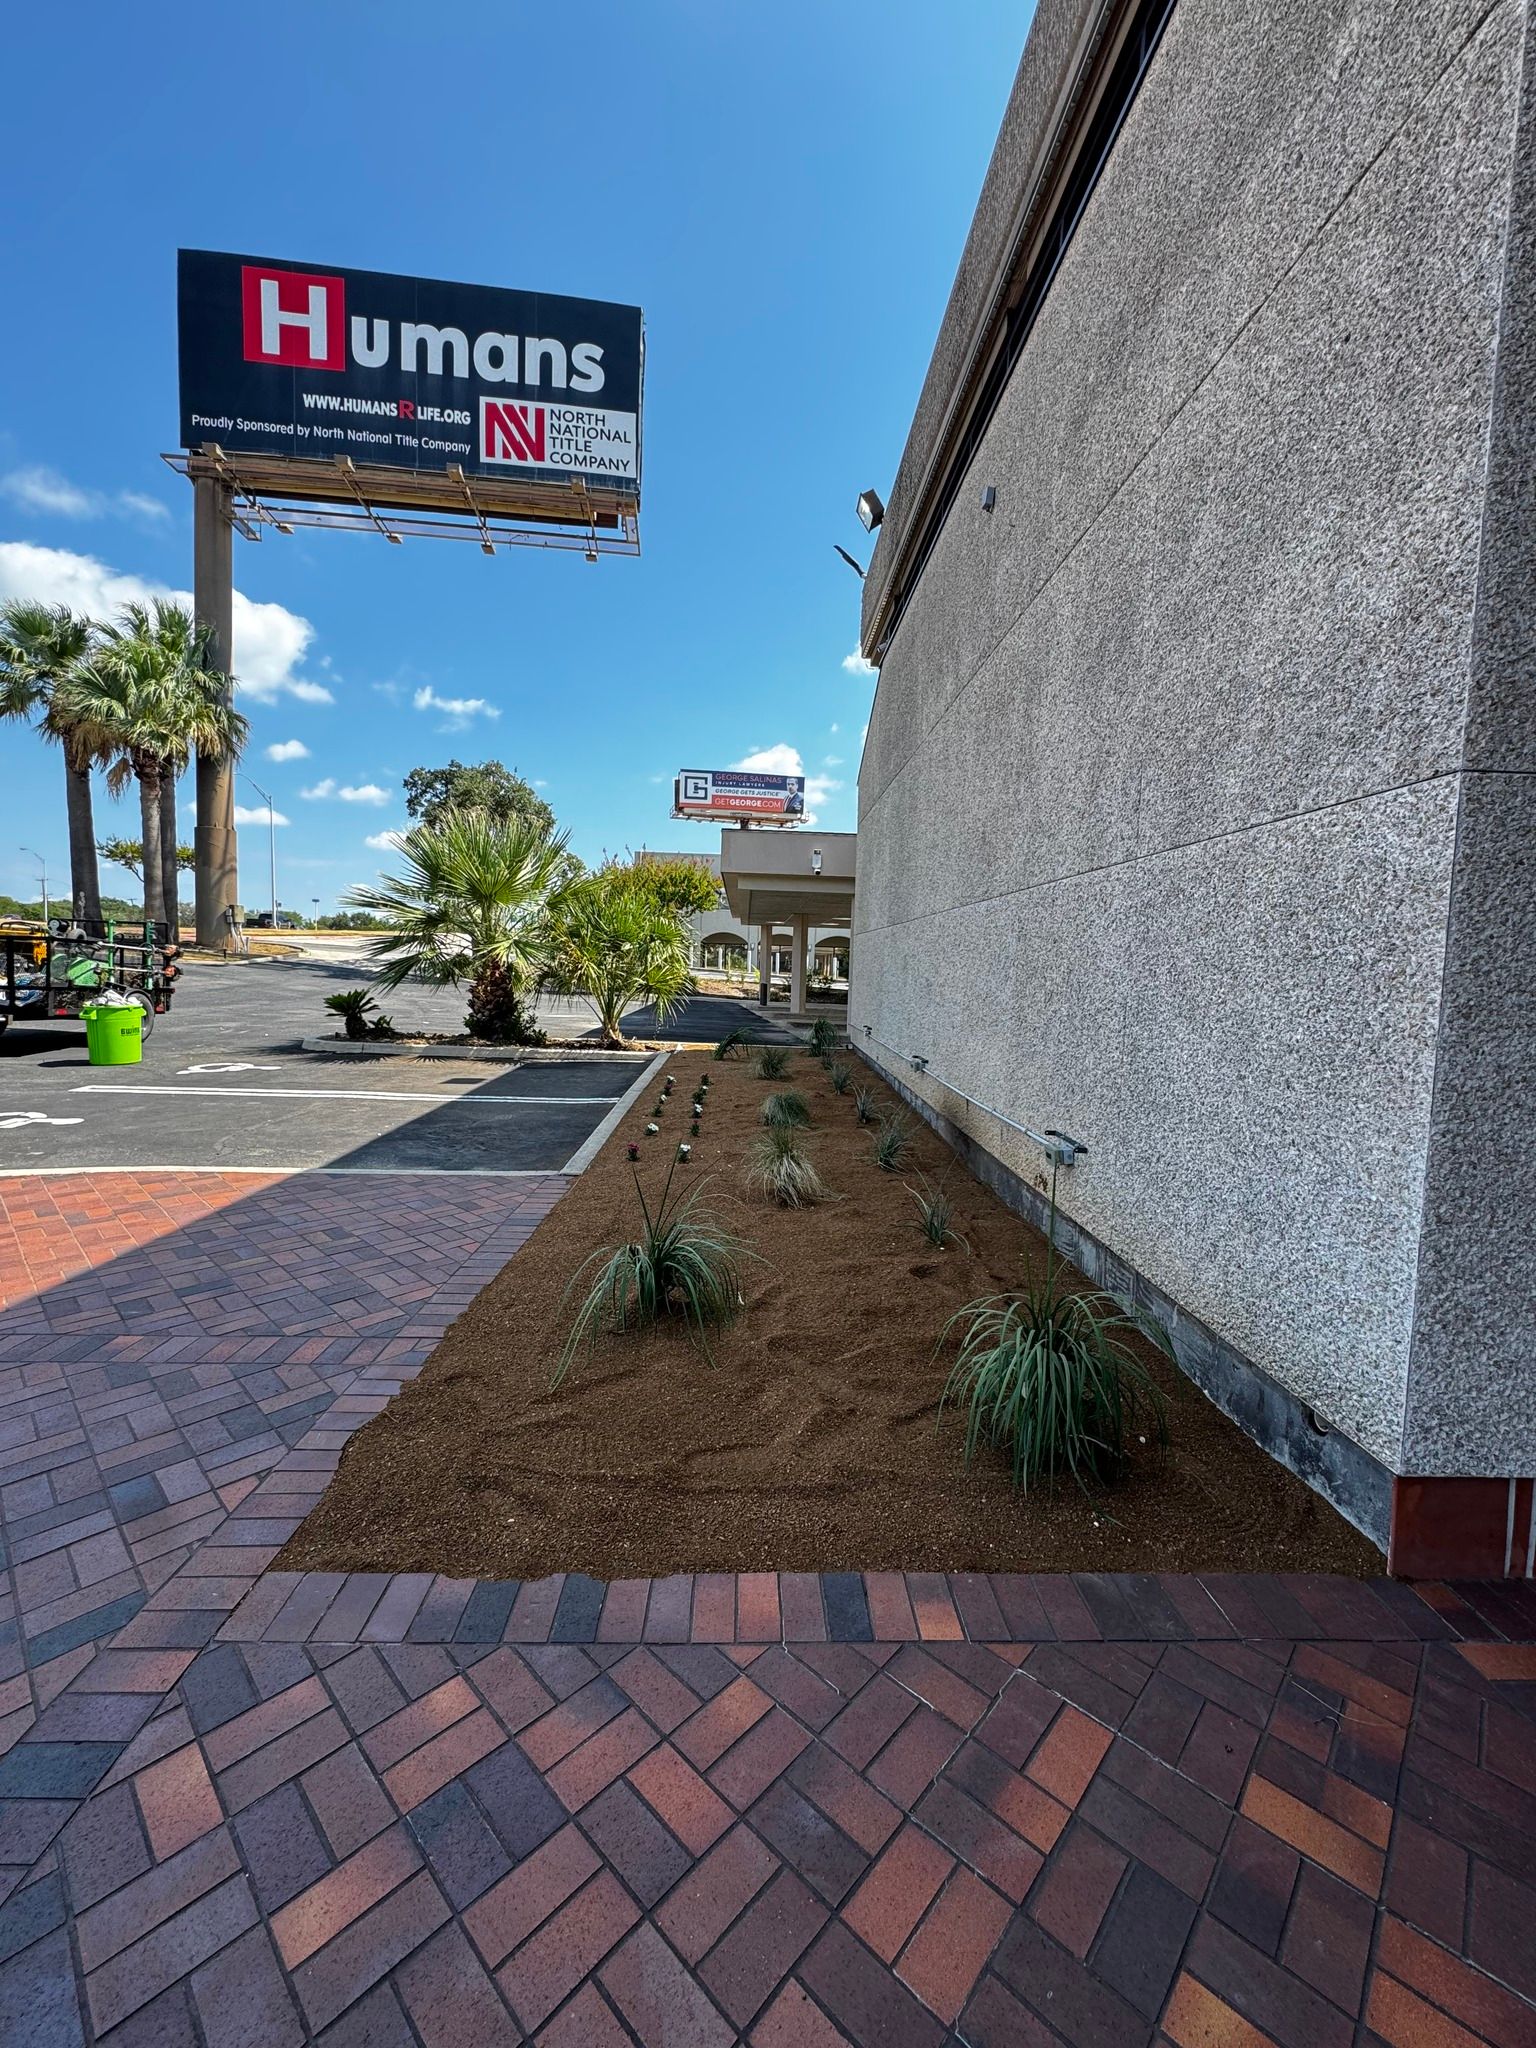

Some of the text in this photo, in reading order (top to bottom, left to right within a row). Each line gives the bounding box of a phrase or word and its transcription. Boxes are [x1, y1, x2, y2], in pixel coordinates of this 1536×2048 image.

[260, 278, 606, 393] Humans
[549, 408, 606, 427] NORTH
[191, 414, 471, 455] Proudly Sponsored by North National Title Company
[549, 422, 632, 444] NATIONAL
[549, 436, 593, 453] TITLE
[549, 451, 631, 473] COMPANY
[715, 773, 782, 784] GEORGE SALINAS
